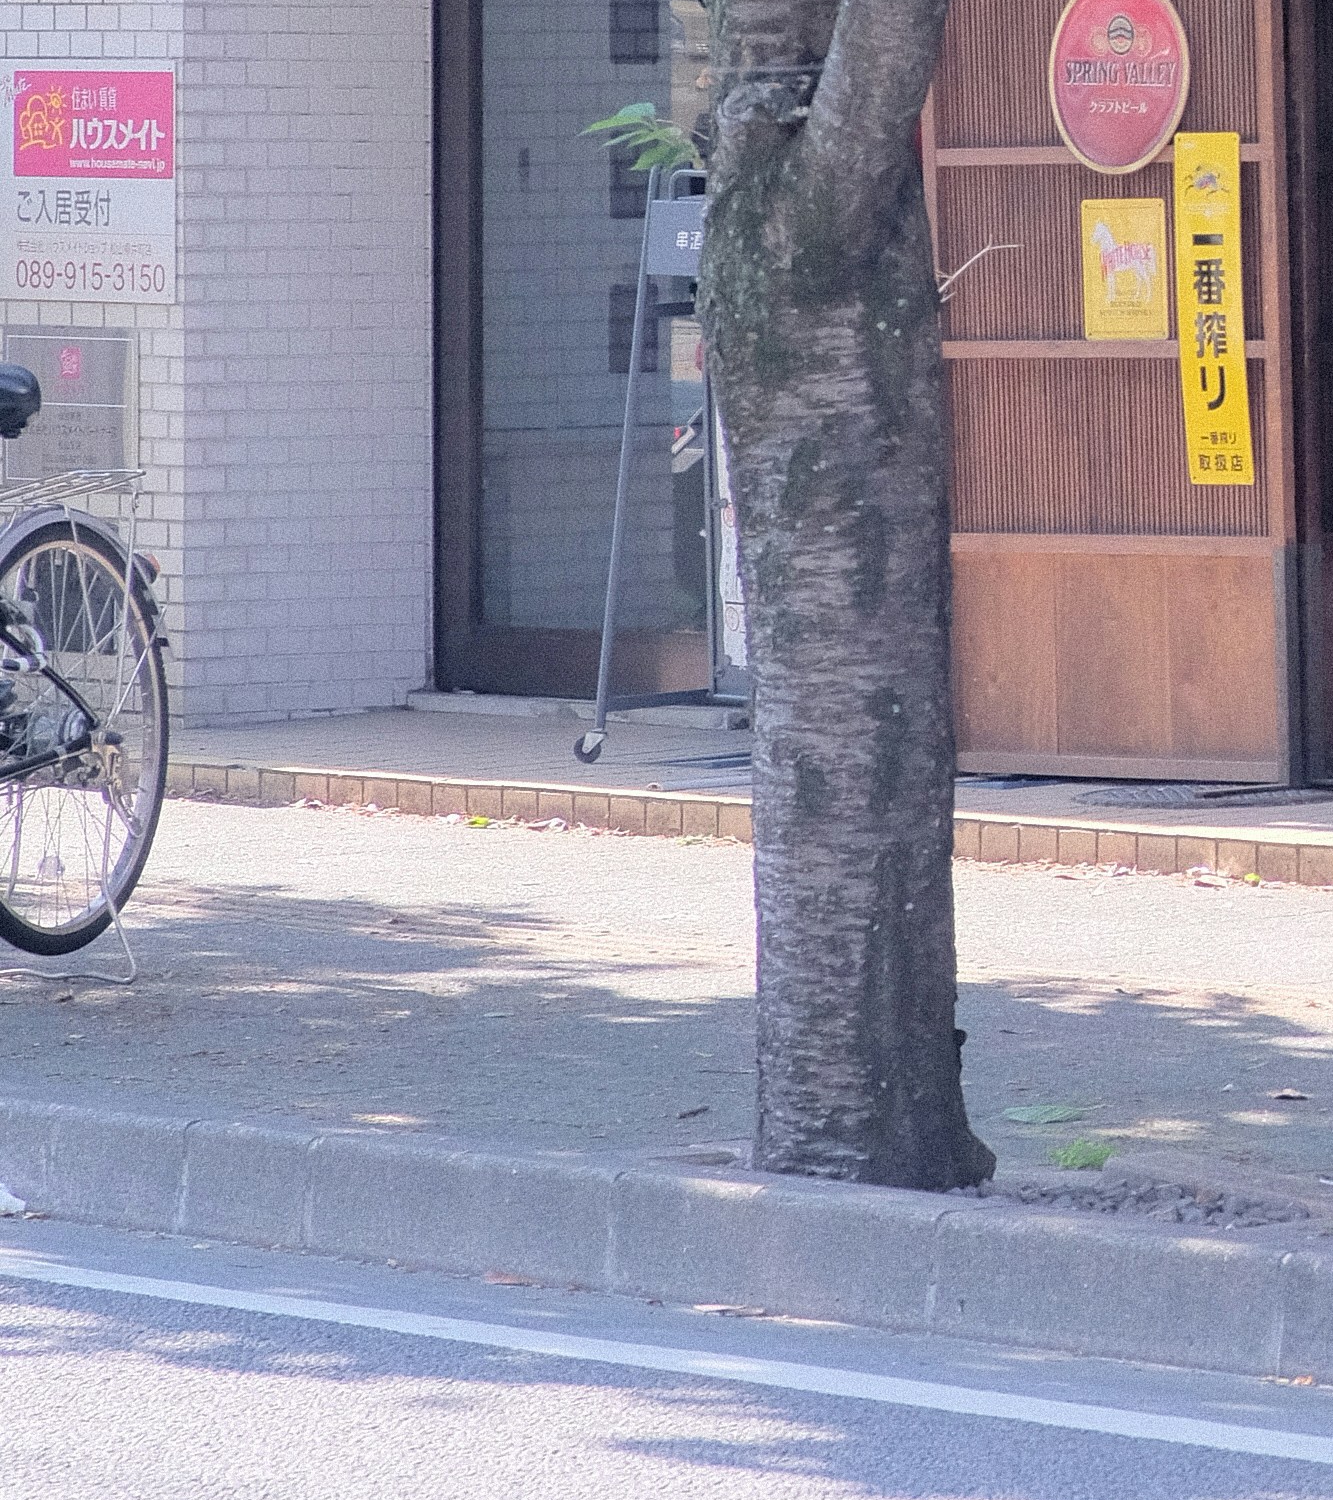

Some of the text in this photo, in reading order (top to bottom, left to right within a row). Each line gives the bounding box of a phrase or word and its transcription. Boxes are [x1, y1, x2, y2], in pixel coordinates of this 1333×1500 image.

[1066, 60, 1177, 87] SPRING VALLEY
[1089, 100, 1149, 114] クラフトビール
[69, 117, 166, 151] ハウスメイト
[16, 189, 112, 228] ご入居受付
[16, 259, 166, 293] 089-915-3150
[1192, 233, 1227, 412] 一番搾り
[1198, 454, 1244, 472] 取扱店
